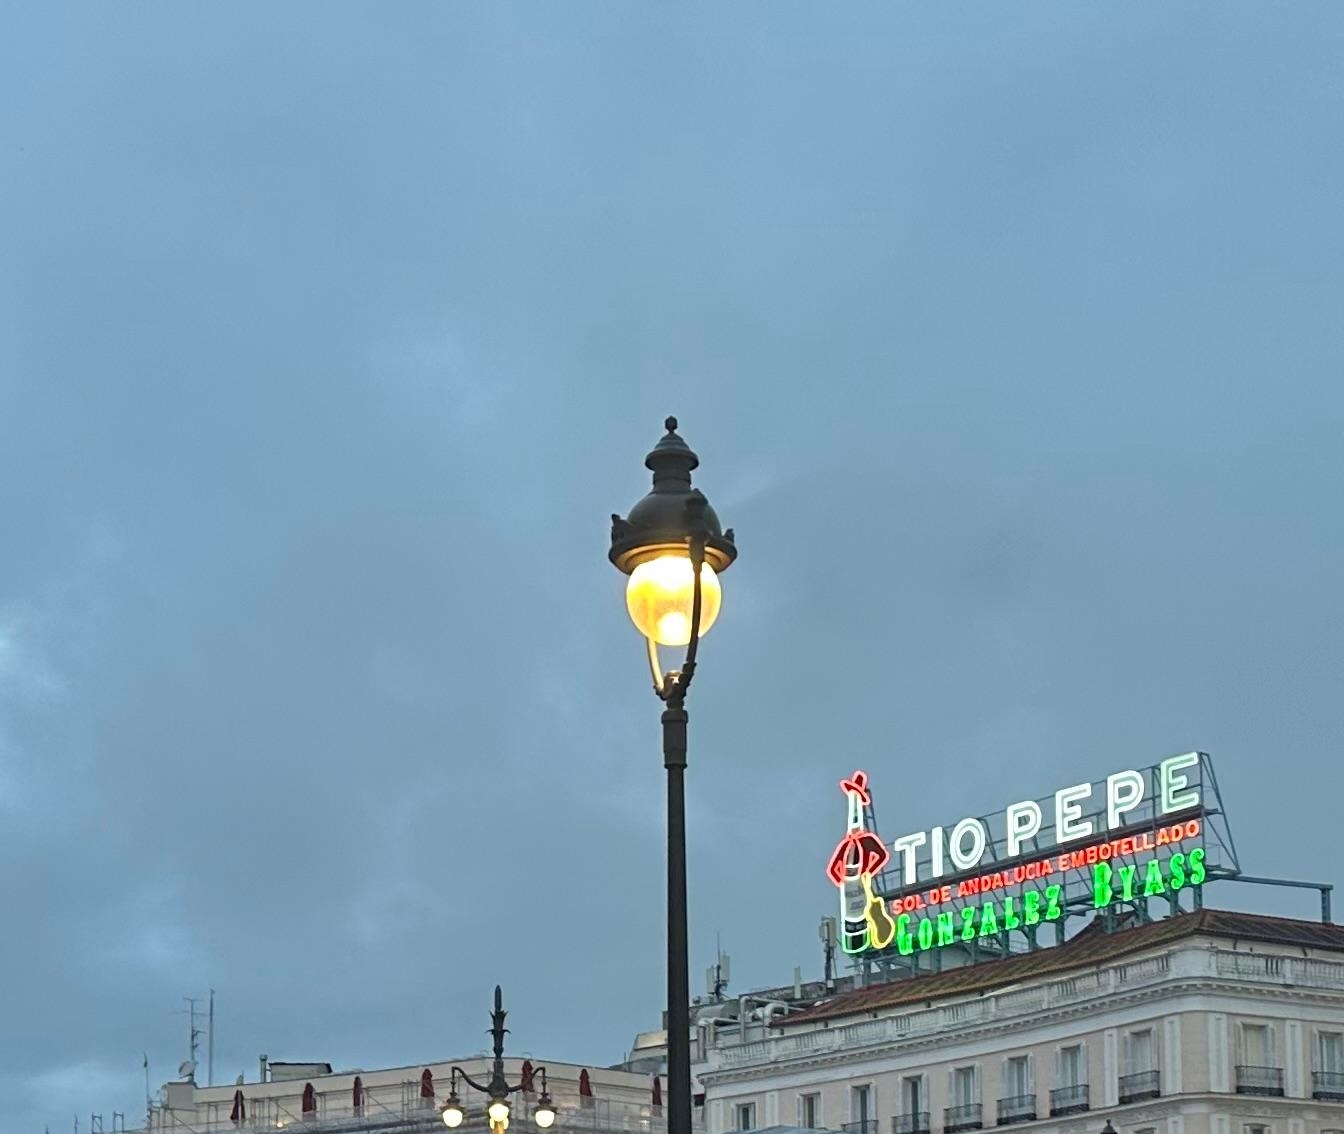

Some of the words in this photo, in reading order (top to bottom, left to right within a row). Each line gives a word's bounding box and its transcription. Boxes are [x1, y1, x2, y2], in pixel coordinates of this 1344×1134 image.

[892, 893, 926, 915] SOL
[929, 887, 952, 905] DE
[1058, 819, 1201, 872] EMBOTELLADO
[894, 817, 987, 885] TIO
[1006, 751, 1200, 857] PEPE
[895, 884, 1063, 956] GONZALEZ
[1093, 846, 1207, 909] BYASS
